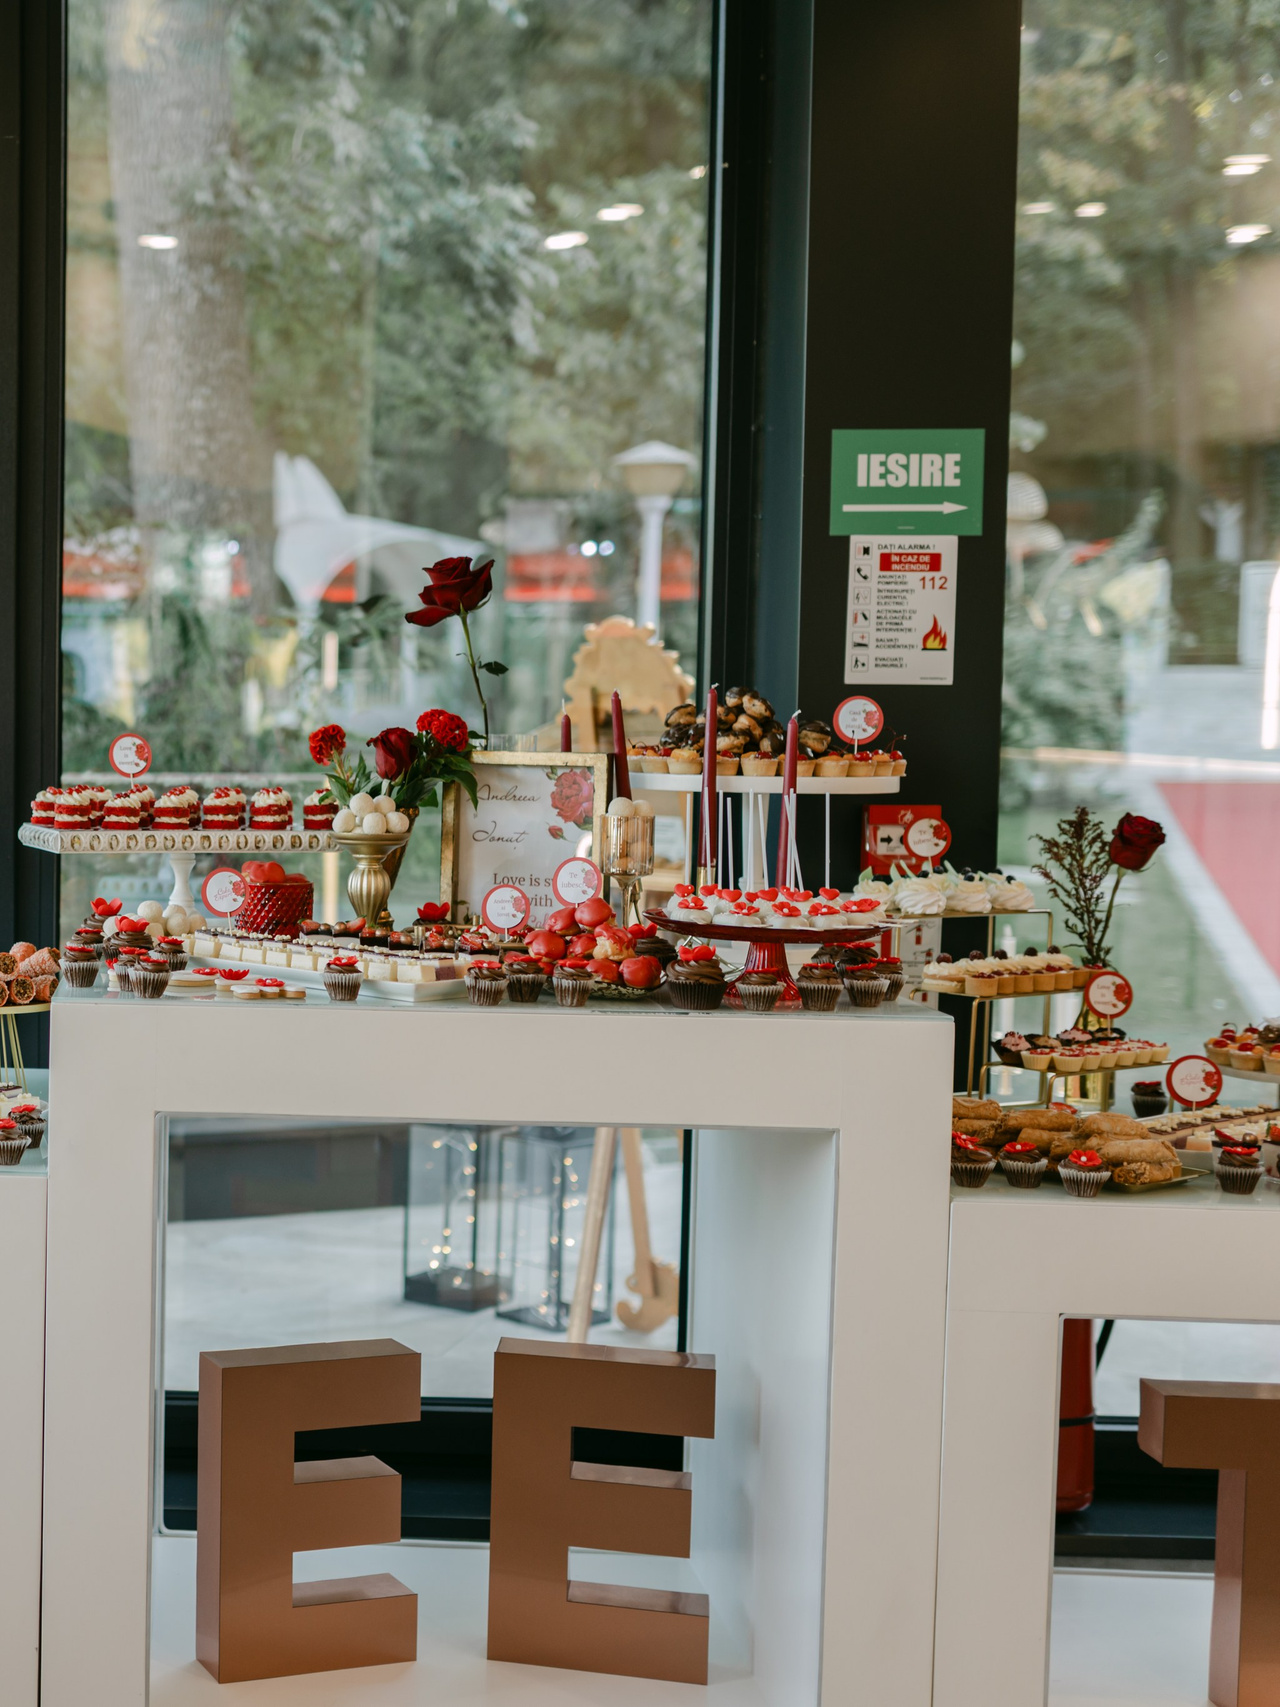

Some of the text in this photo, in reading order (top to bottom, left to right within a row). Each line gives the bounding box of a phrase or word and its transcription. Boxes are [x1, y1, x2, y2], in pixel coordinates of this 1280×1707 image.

[857, 453, 961, 487] IESIRE
[891, 554, 900, 562] ÎN
[891, 563, 930, 571] INCENDIU
[919, 576, 949, 590] 112
[493, 873, 526, 886] Love
[529, 874, 540, 887] is
